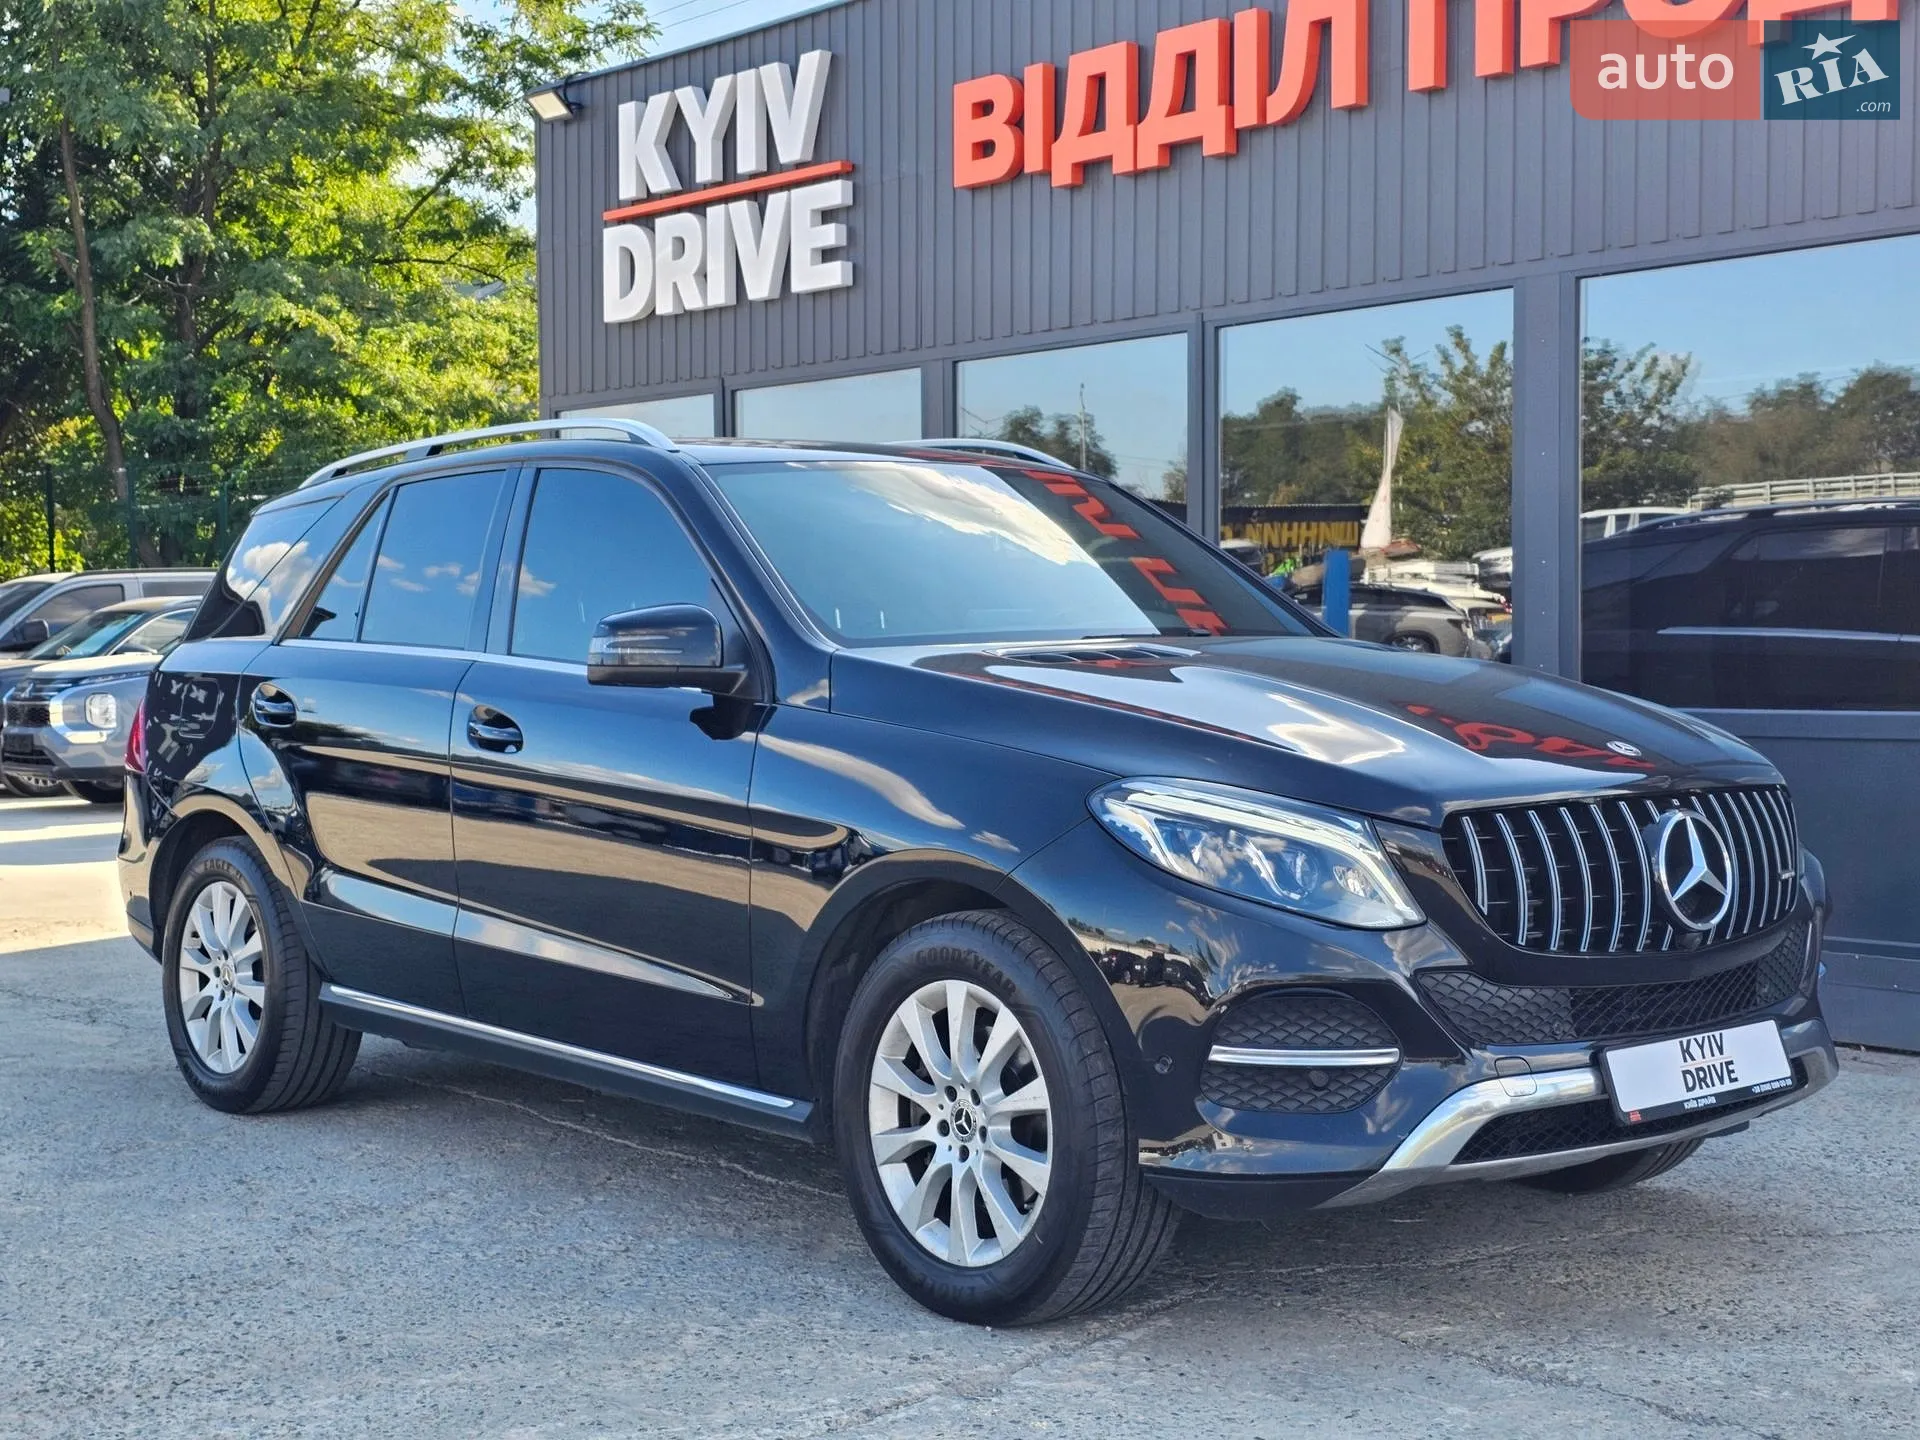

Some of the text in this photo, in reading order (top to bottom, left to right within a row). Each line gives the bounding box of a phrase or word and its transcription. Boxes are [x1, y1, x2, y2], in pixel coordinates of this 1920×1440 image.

[618, 49, 832, 201] KYIV
[953, 0, 1899, 189] ВІДДІЛ ПР
[602, 179, 854, 323] DRIVE
[1679, 1032, 1725, 1063] KYIV
[1681, 1060, 1739, 1093] DRIVE
